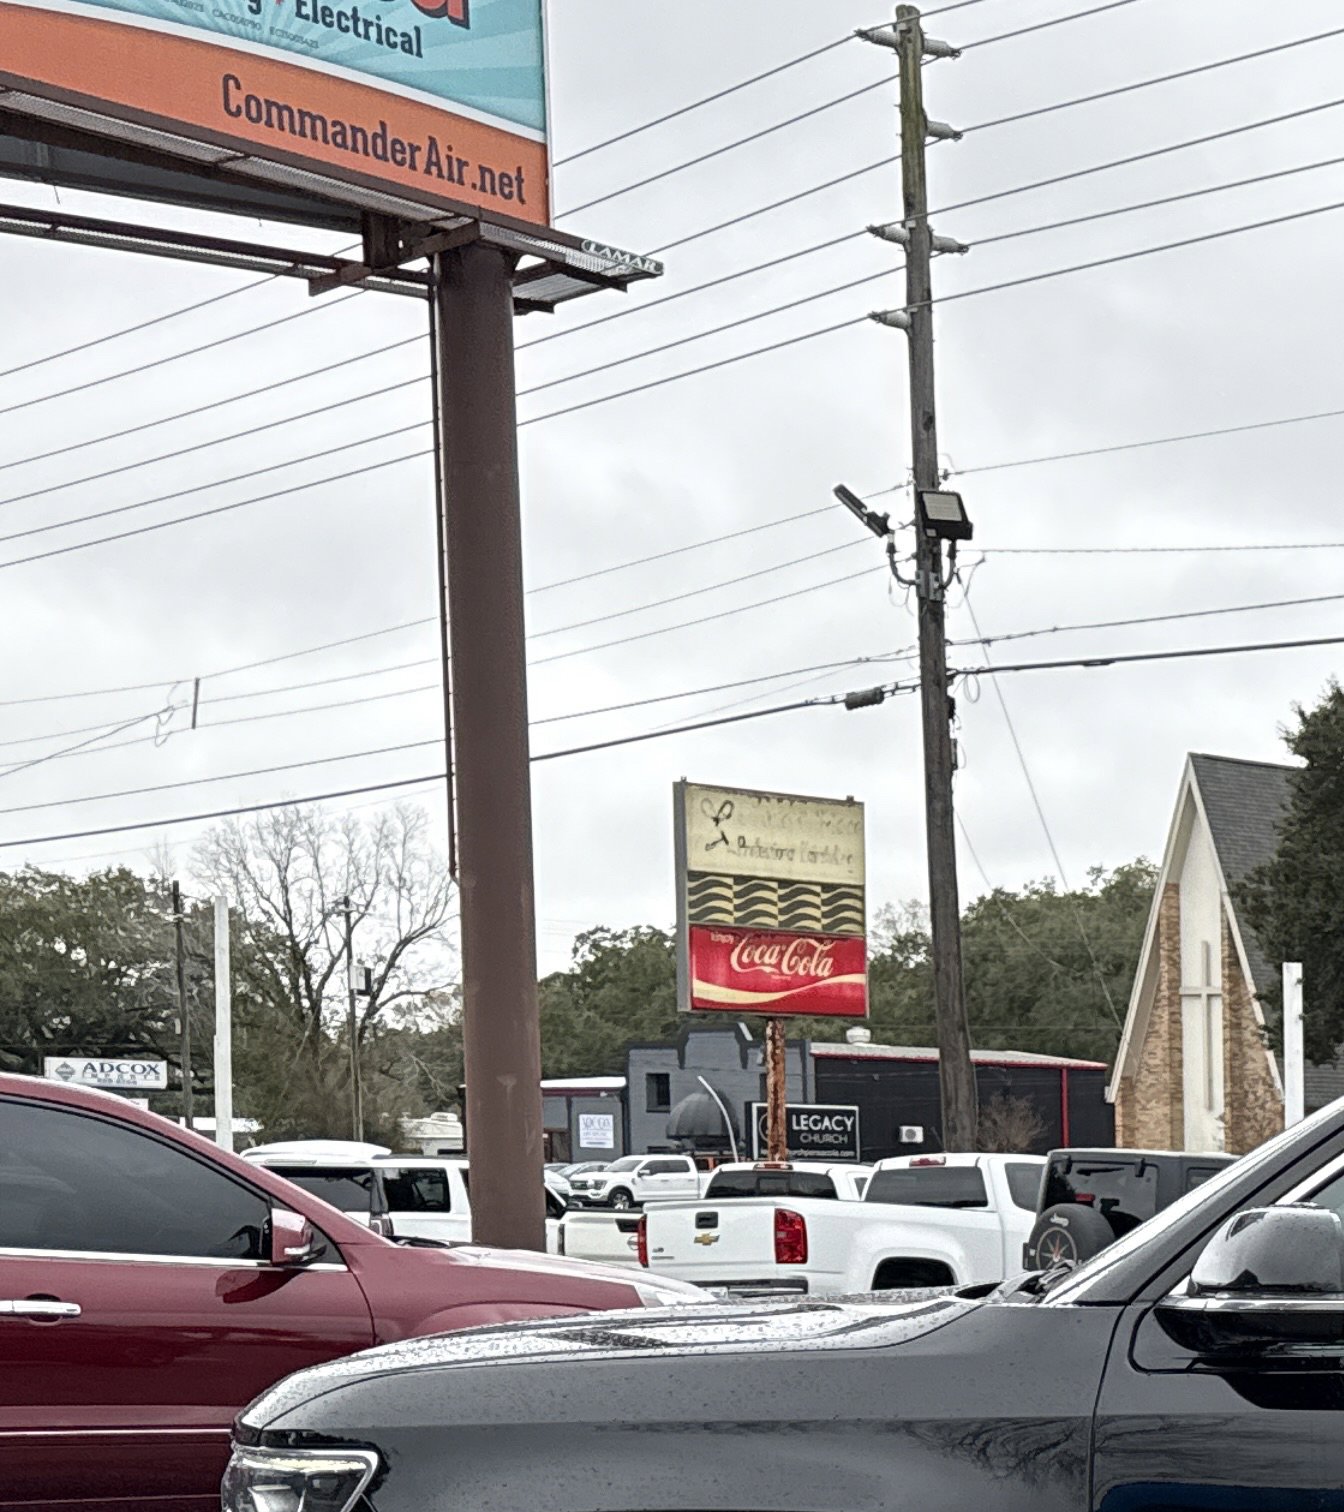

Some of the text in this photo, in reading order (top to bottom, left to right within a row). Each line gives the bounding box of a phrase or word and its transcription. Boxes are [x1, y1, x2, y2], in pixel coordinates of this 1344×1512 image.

[295, 0, 423, 58] Electrical
[221, 73, 526, 205] CommanderAir.net
[588, 242, 658, 274] LAMAR
[83, 1062, 161, 1075] ADCOX
[791, 1114, 855, 1132] LEGACY
[799, 1132, 849, 1145] CHURCH
